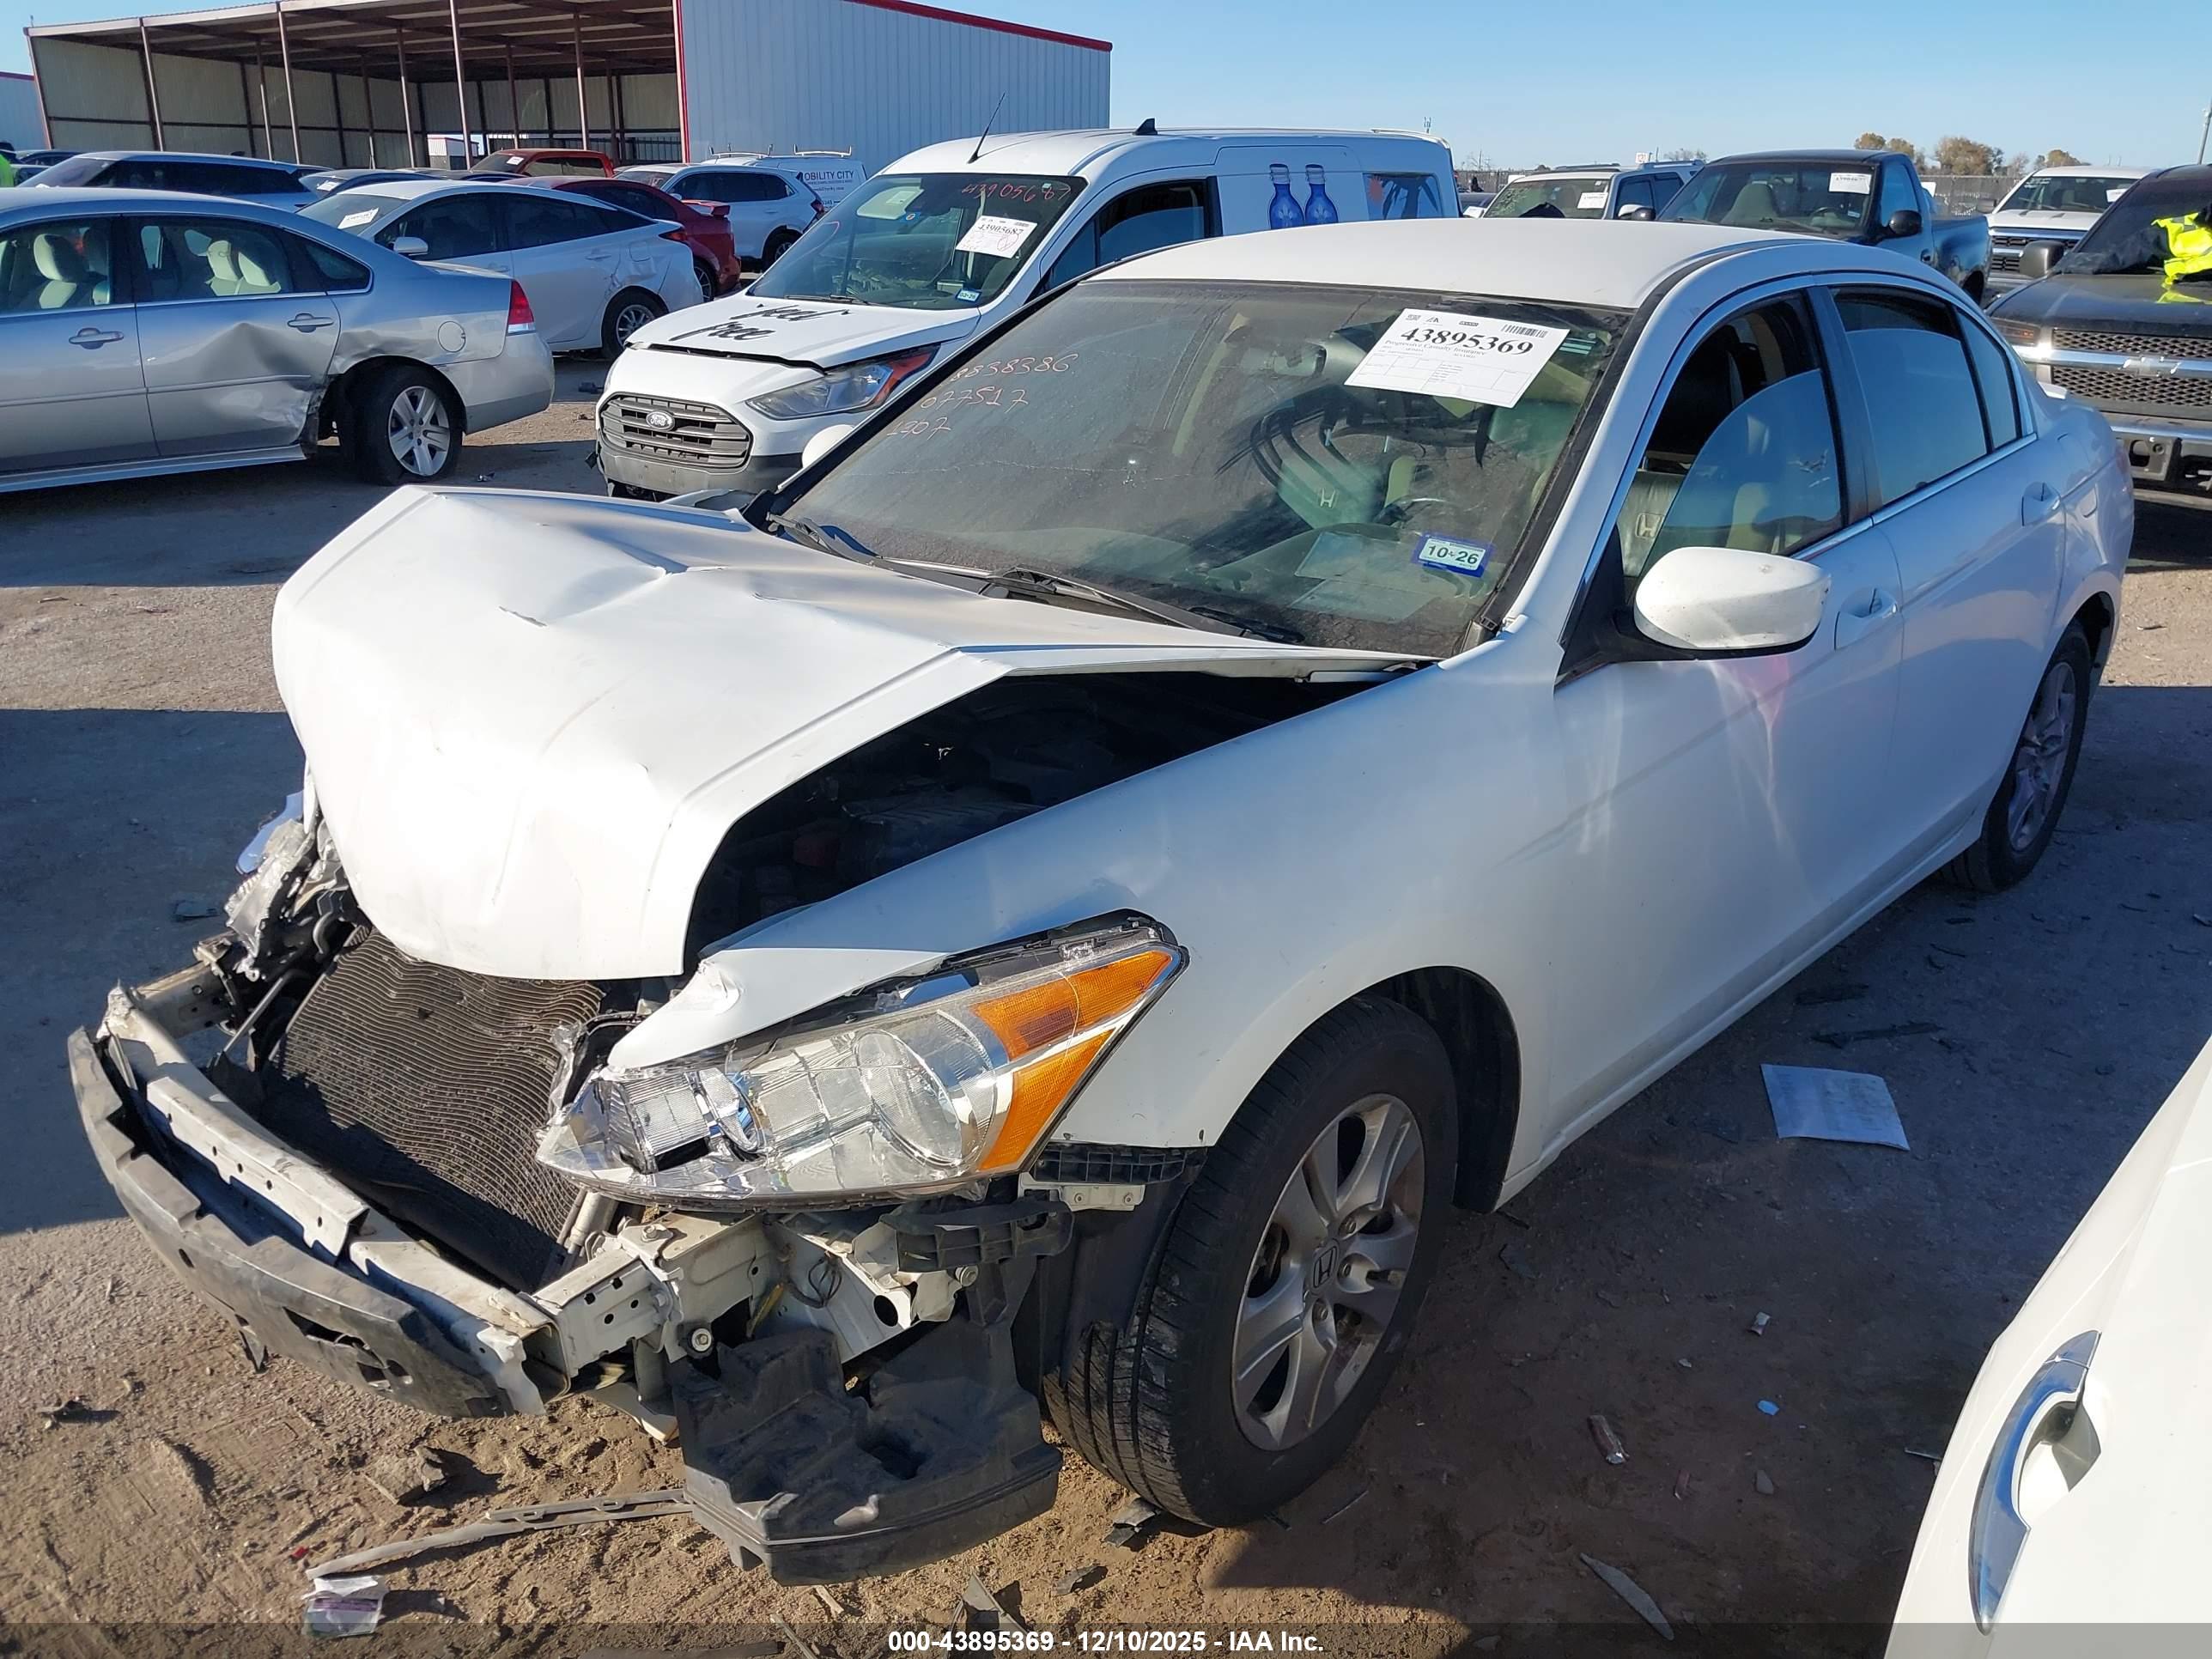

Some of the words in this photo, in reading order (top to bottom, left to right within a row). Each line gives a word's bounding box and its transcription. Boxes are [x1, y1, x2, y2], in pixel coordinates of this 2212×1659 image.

[803, 171, 835, 181] OBILITY
[836, 170, 854, 179] CITY
[1401, 327, 1534, 356] 43895369
